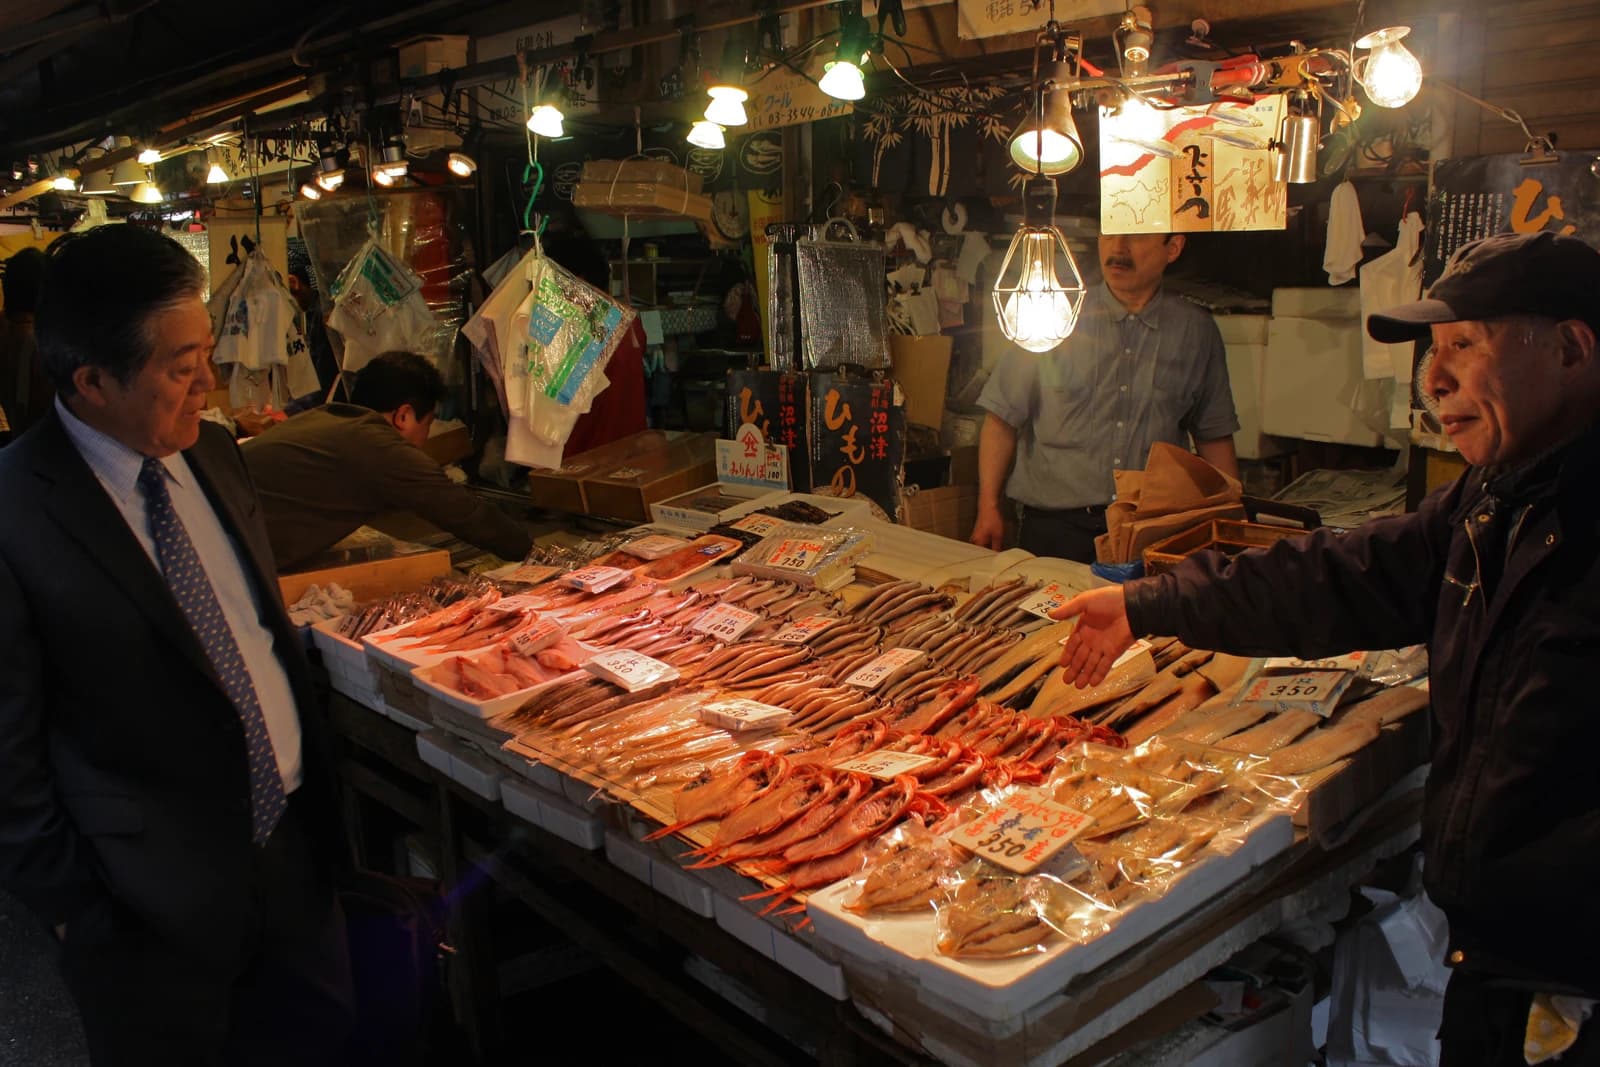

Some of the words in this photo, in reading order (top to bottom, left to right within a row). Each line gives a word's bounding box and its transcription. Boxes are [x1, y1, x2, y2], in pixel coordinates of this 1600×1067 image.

[780, 405, 798, 450] 沼津
[869, 411, 889, 461] 沼津
[824, 388, 865, 498] ひもの
[768, 471, 780, 480] 100
[782, 557, 805, 568] 750
[706, 623, 736, 635] 1000
[606, 657, 633, 674] 350
[1269, 685, 1318, 697] 350
[978, 832, 1026, 857] 350
